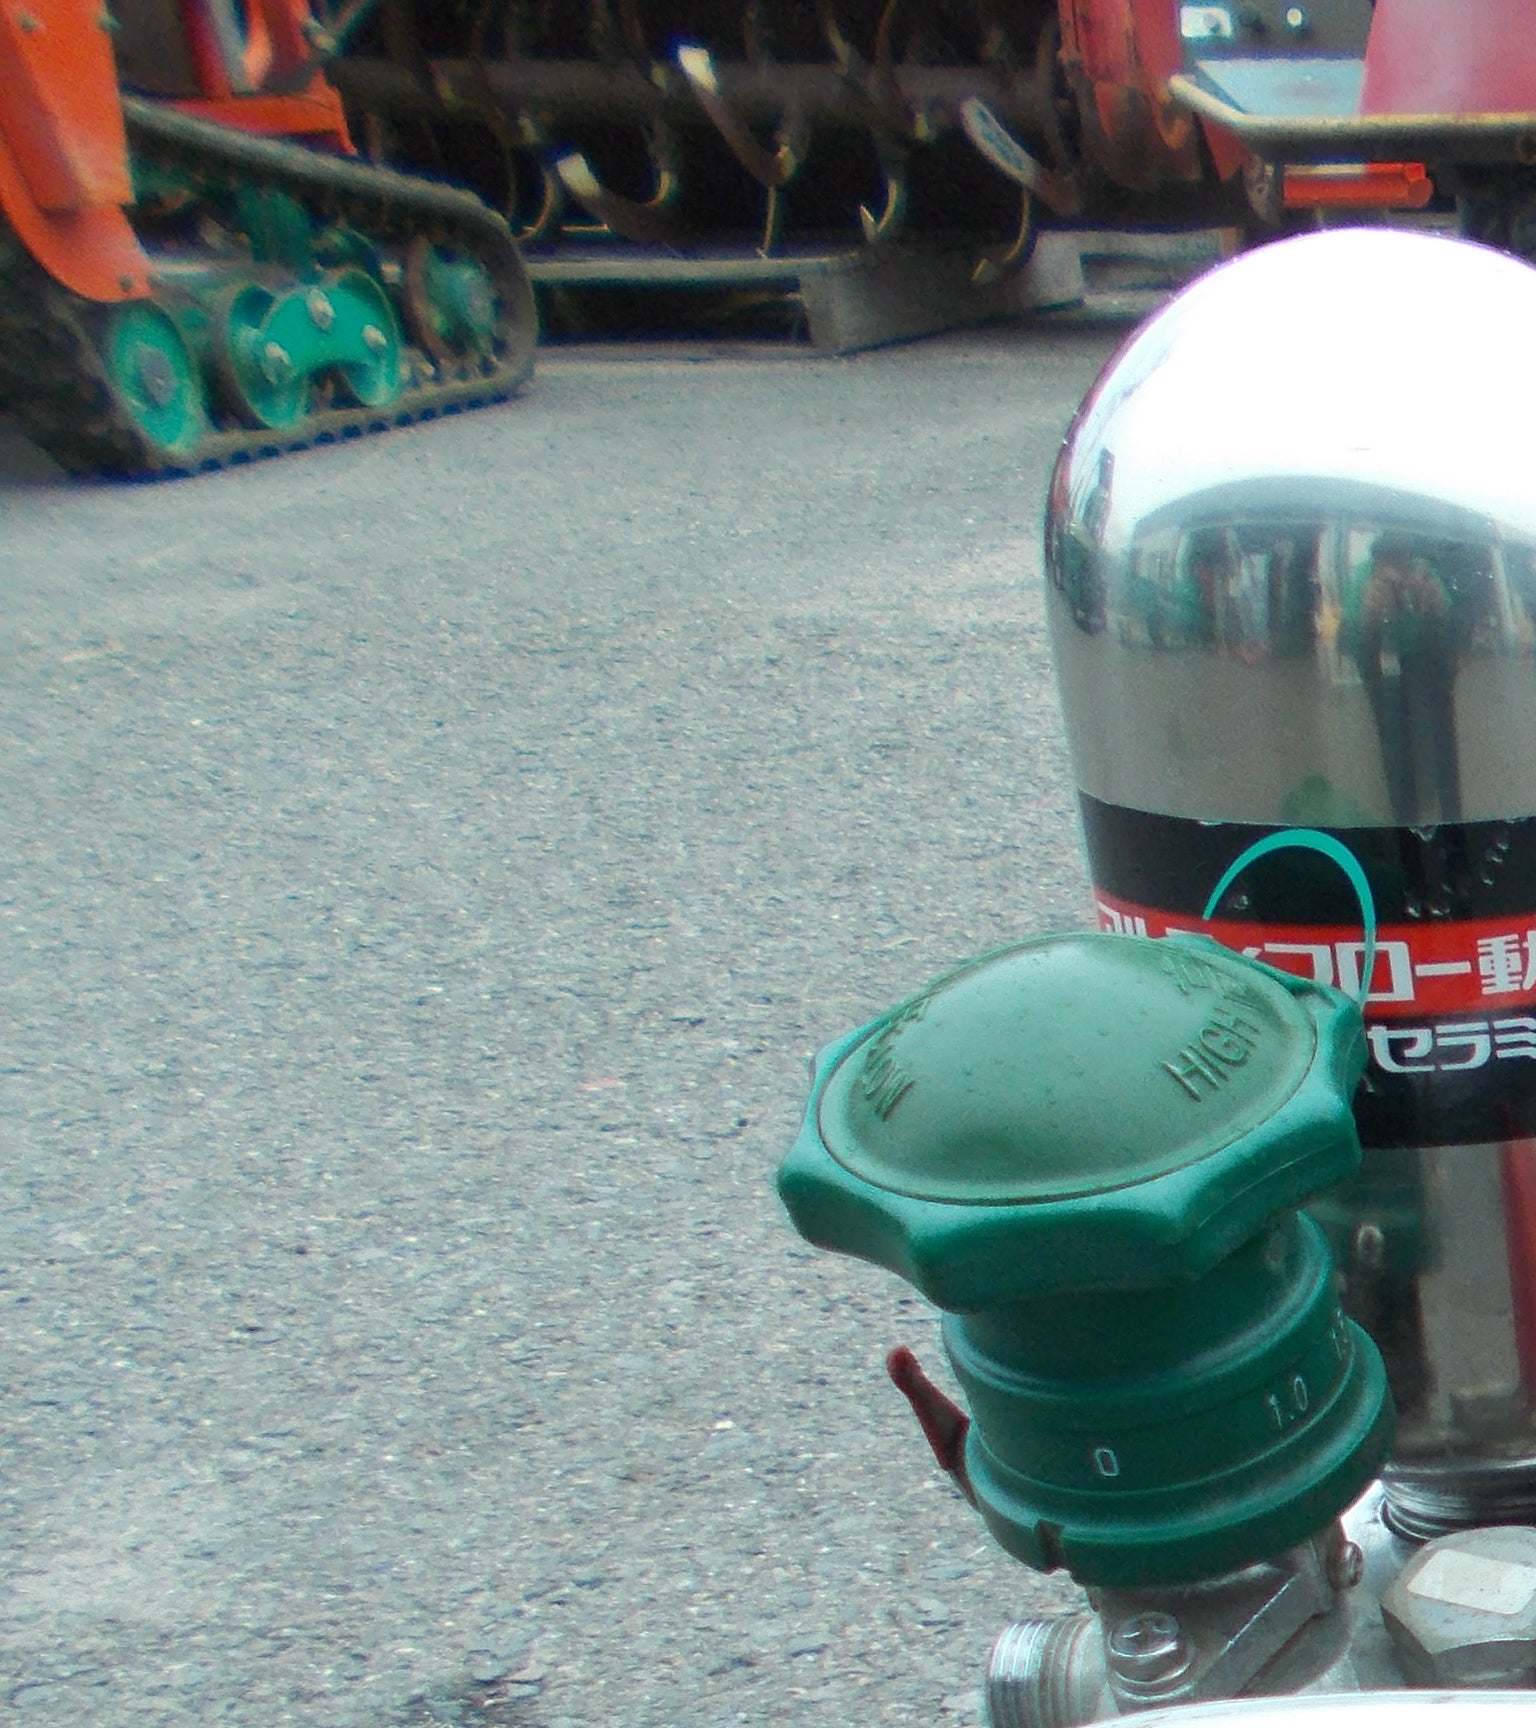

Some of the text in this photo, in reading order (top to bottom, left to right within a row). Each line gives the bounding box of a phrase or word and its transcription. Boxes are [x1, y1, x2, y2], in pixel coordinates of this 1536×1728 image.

[1162, 1006, 1262, 1103] HIGH
[1268, 1375, 1308, 1430] 1.0
[1094, 1448, 1120, 1477] 0
